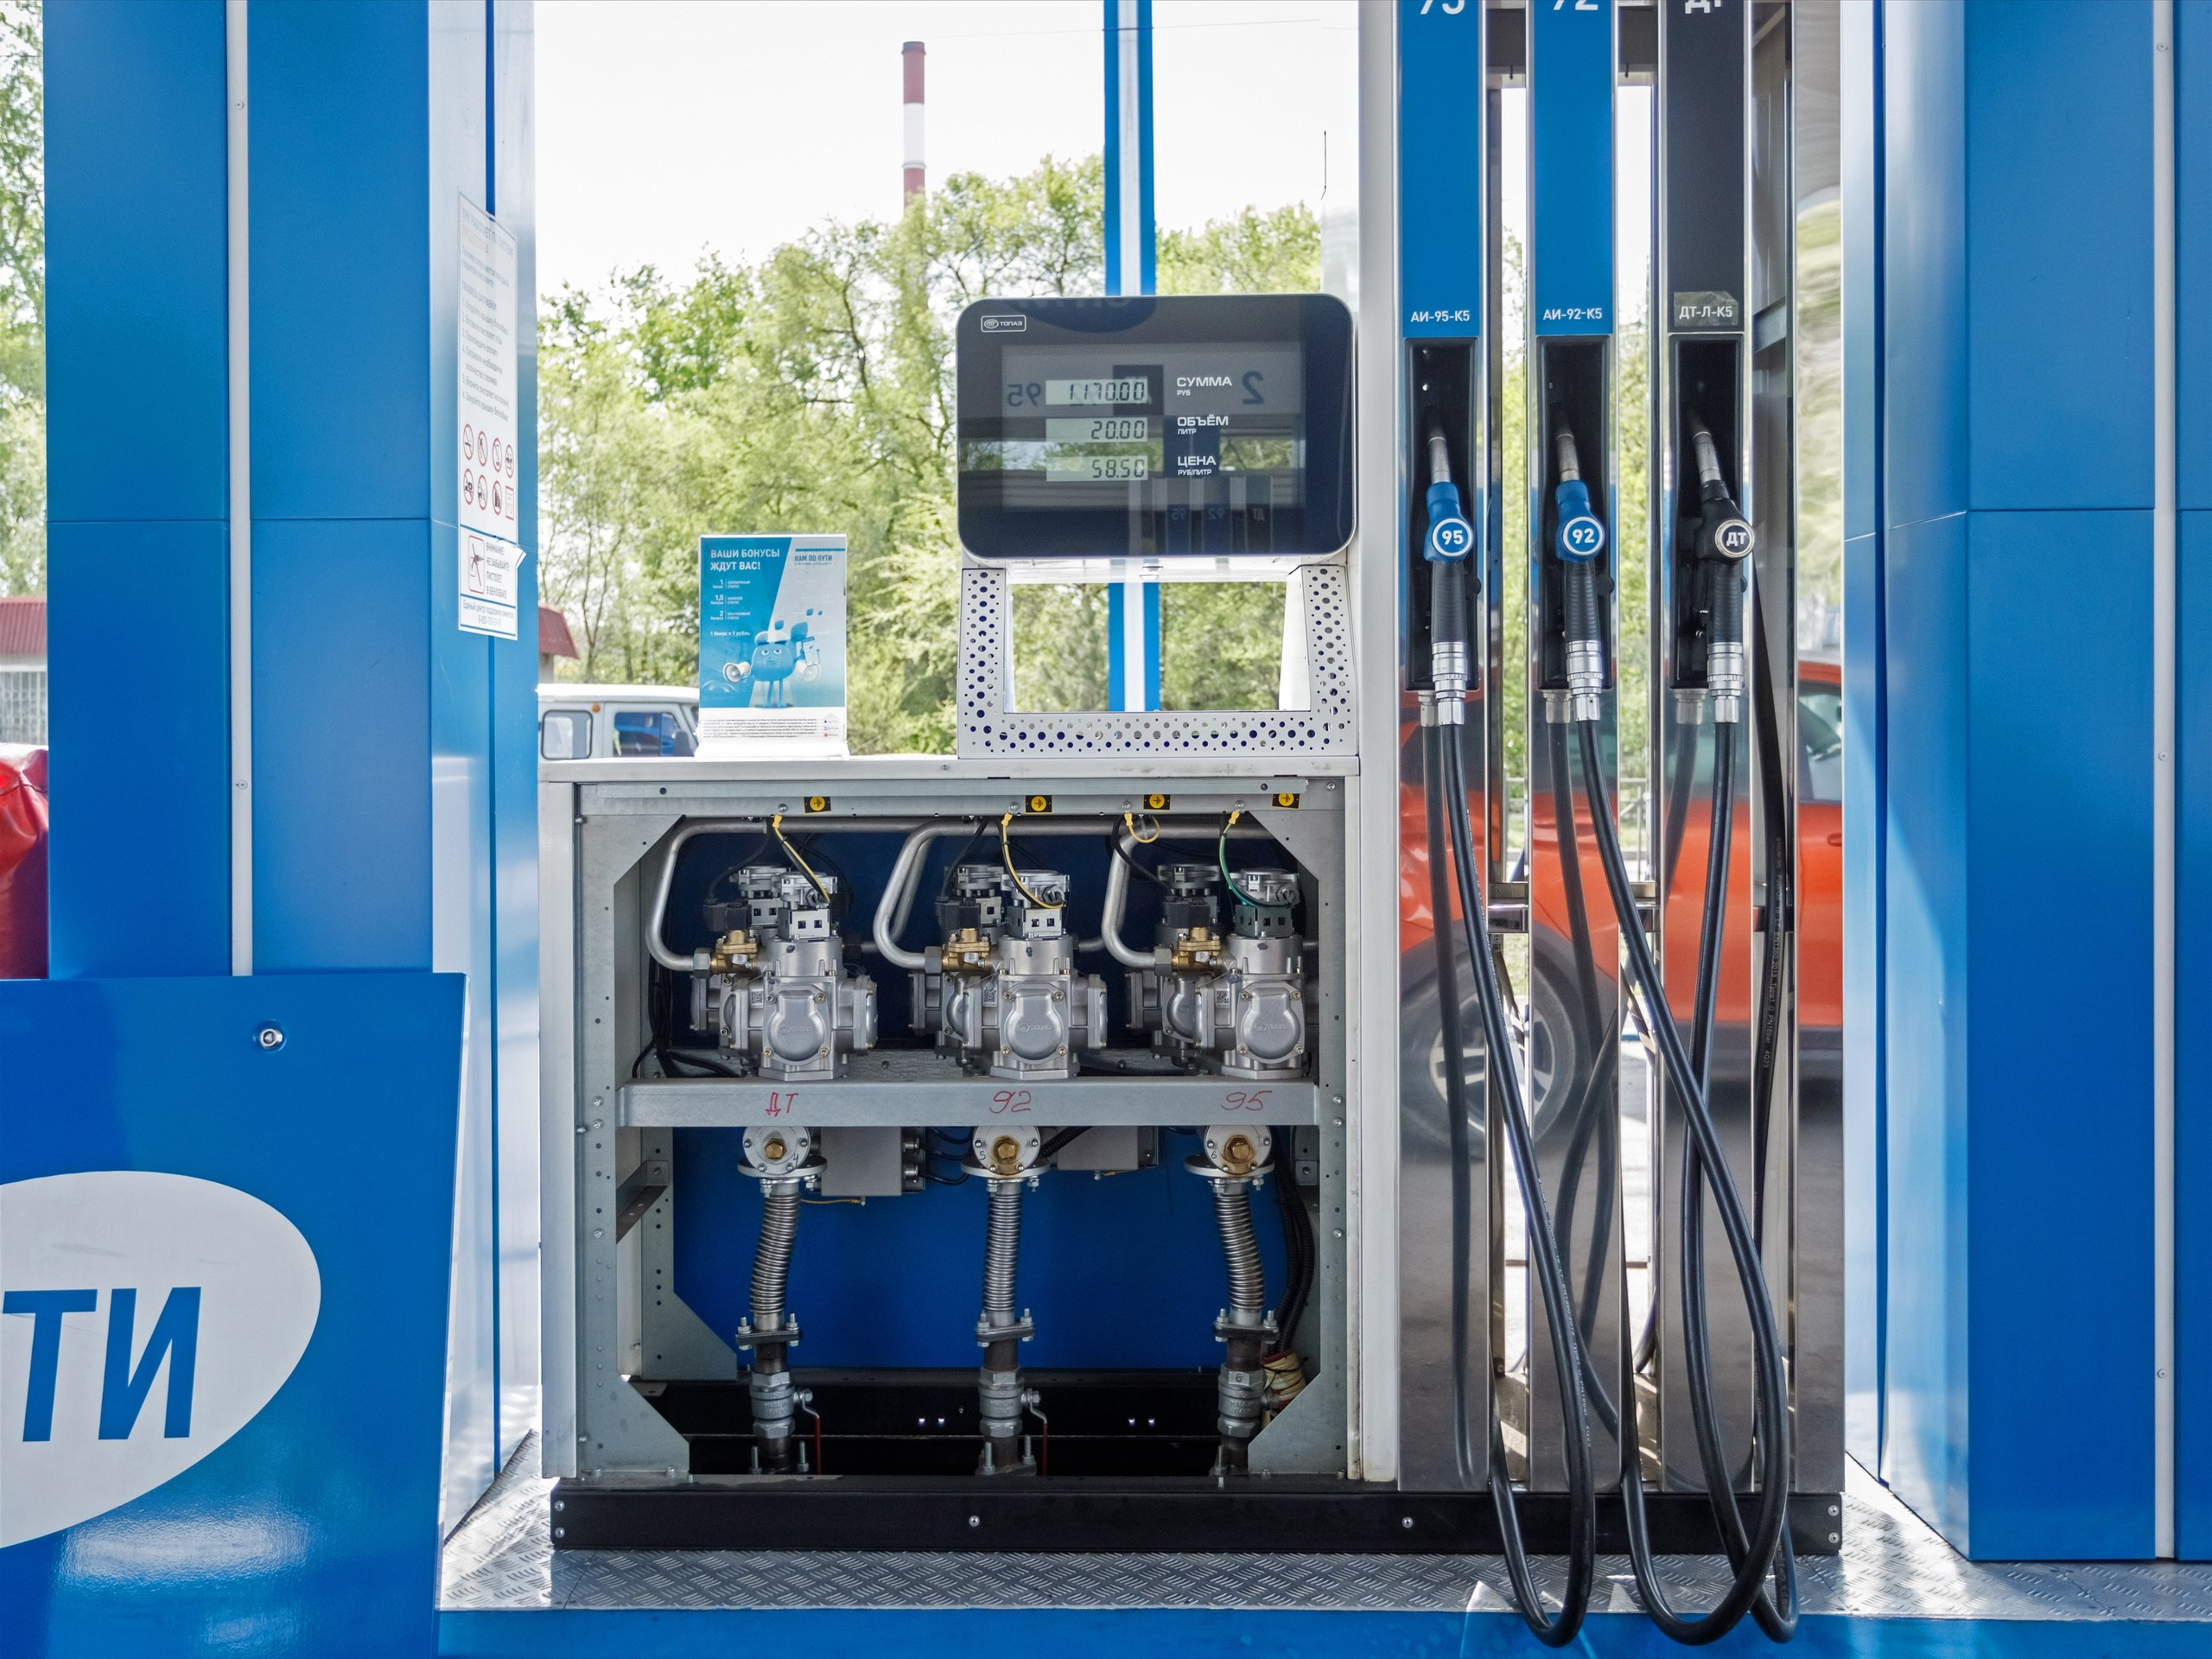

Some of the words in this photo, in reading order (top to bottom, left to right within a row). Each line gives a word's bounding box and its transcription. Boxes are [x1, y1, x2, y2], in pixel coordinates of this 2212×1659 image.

[1410, 311, 1471, 322] АИ-95-К5
[1542, 308, 1603, 321] АИ-92-К5
[1679, 306, 1732, 320] ДТ-Л-К5
[1177, 377, 1232, 387] СУММА
[1177, 415, 1229, 426] ОБЪЁМ
[1091, 420, 1145, 440] 20.00
[1177, 455, 1217, 467] ЦЕНА
[1092, 459, 1145, 478] 58.50
[1441, 530, 1464, 545] 95
[1572, 529, 1595, 543] 92
[1726, 531, 1750, 547] ДТ
[711, 550, 739, 558] ВАШИ
[741, 549, 780, 557] БОНУСЫ
[710, 562, 737, 572] ЖДУТ
[739, 562, 760, 570] ВАС!
[1764, 1014, 1774, 1044] PN16bar
[765, 1091, 798, 1116] ДТ
[989, 1090, 1032, 1114] 92
[1221, 1090, 1273, 1111] 95
[3, 1287, 201, 1442] ТИ
